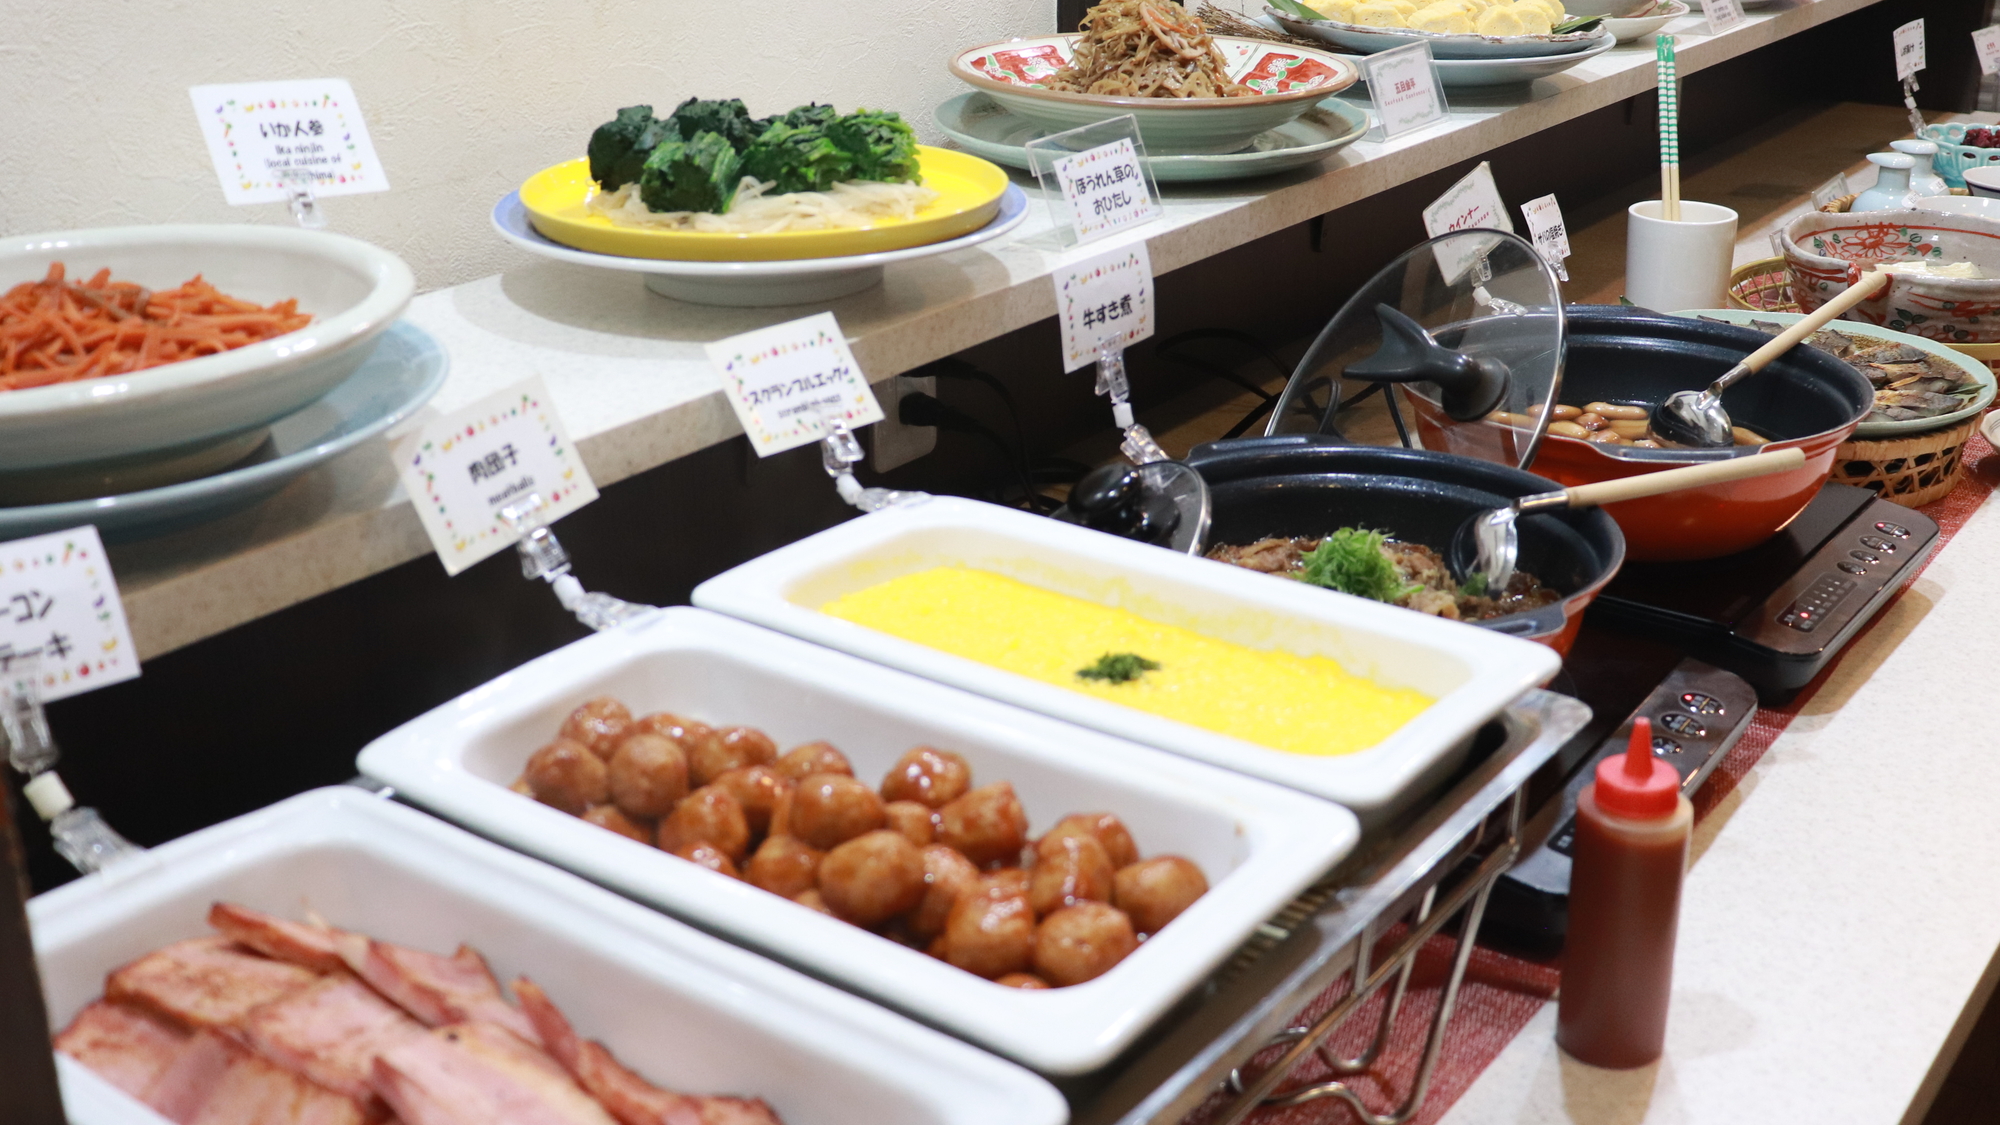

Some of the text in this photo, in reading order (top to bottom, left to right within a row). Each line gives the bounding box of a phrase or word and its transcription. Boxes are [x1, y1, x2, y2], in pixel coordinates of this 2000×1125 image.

[1075, 163, 1135, 196] ほうれん草の
[1093, 190, 1132, 215] おひたし
[1083, 293, 1133, 330] 牛すき煮
[468, 443, 518, 485] 肉団子
